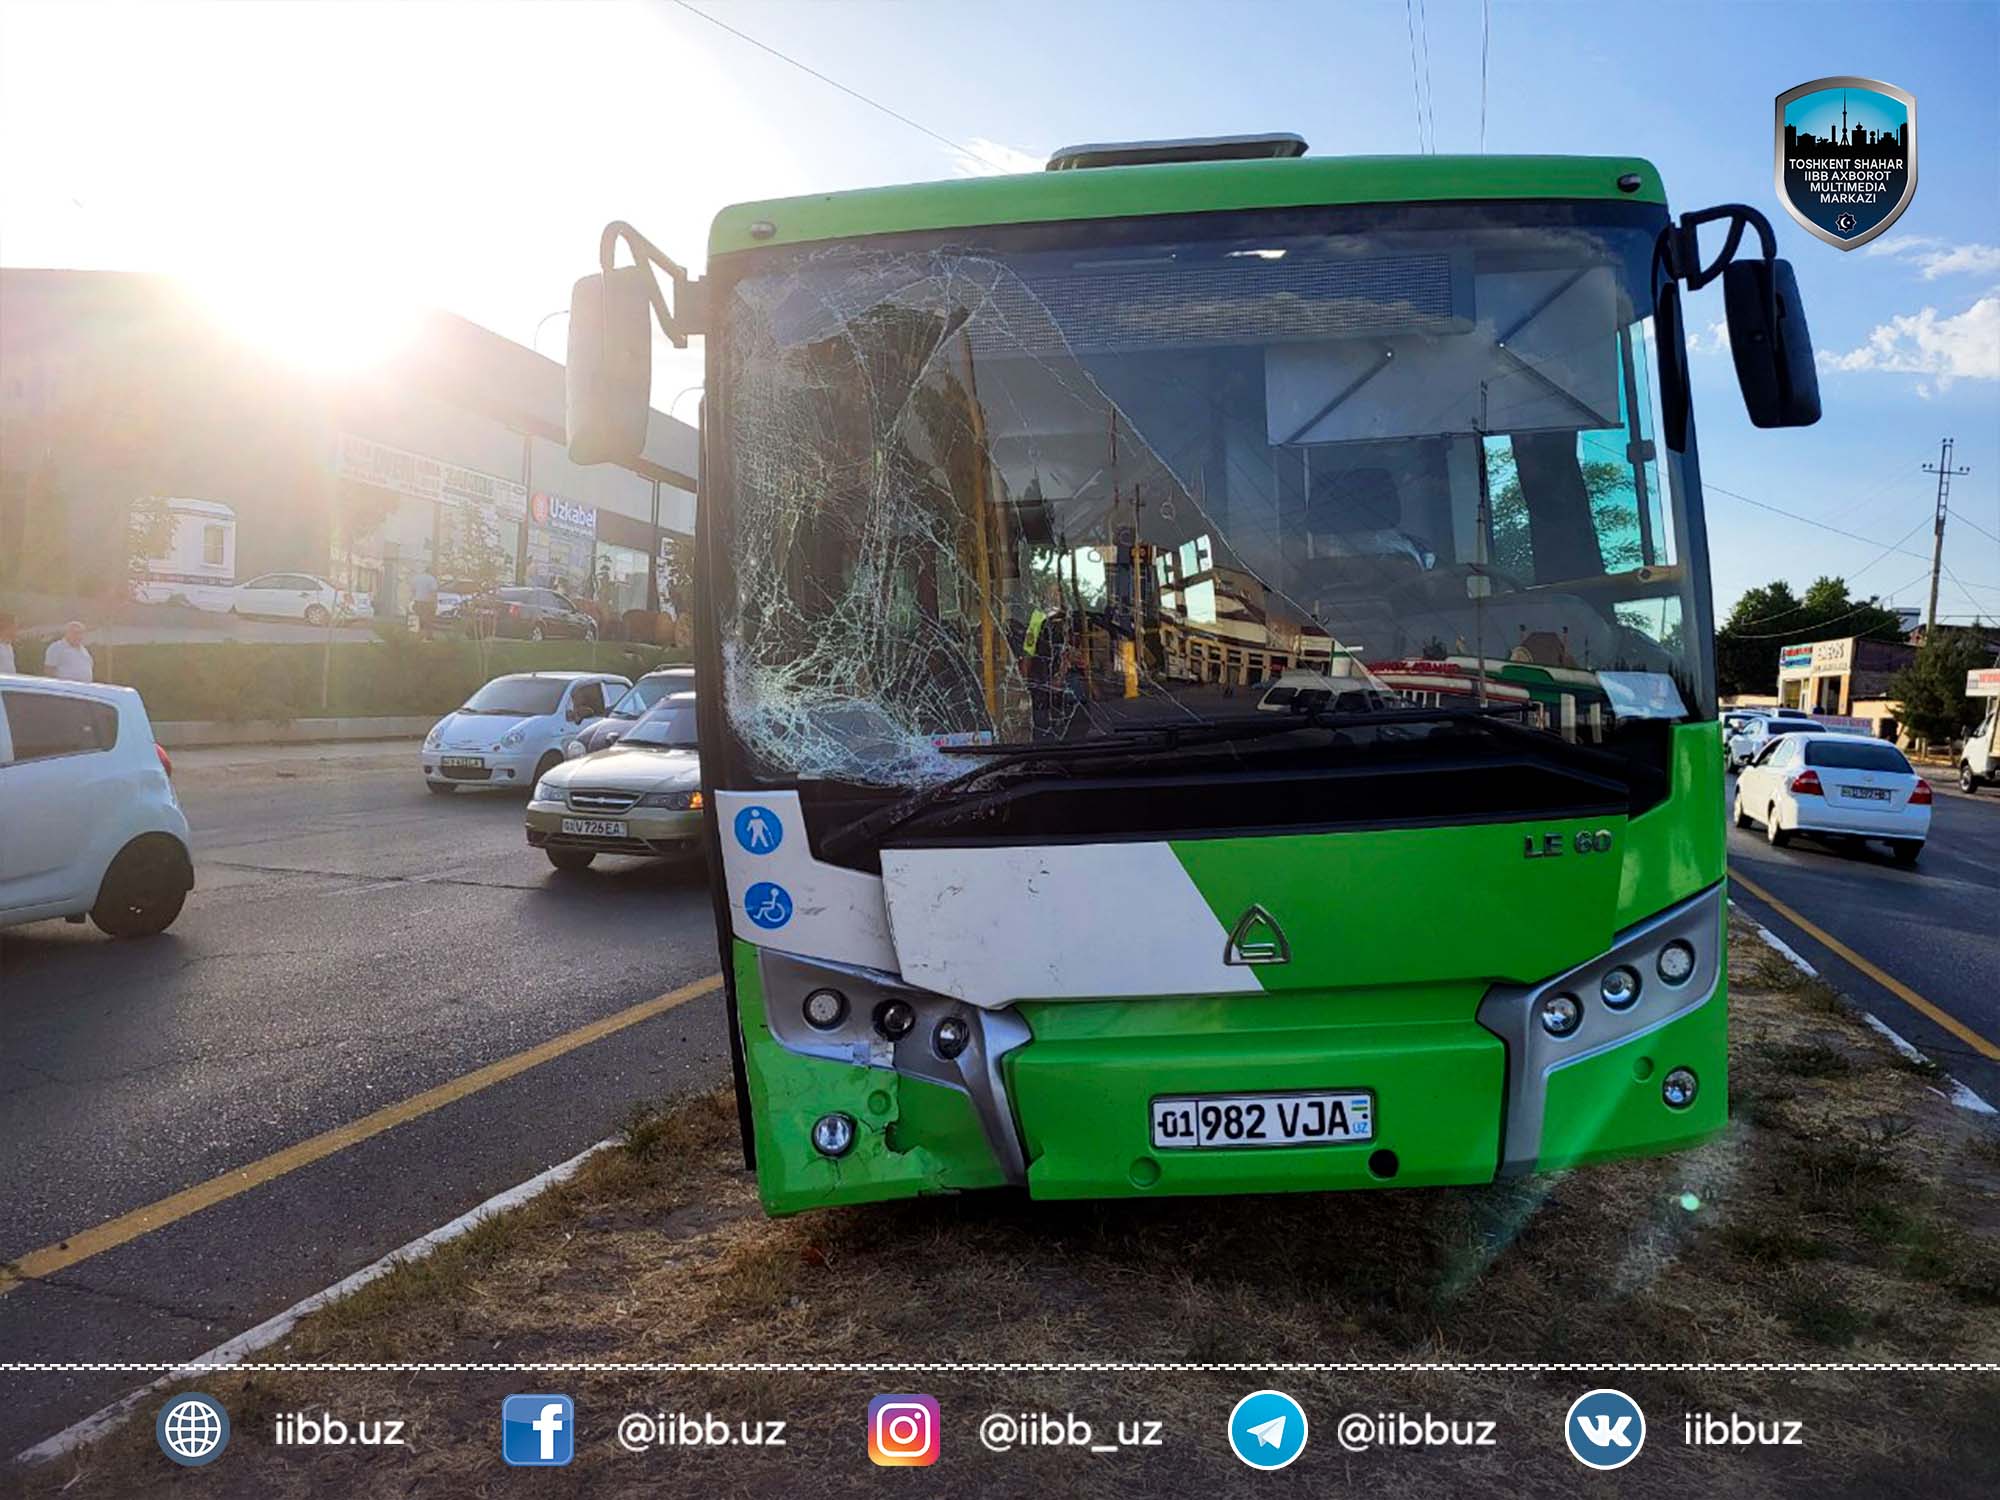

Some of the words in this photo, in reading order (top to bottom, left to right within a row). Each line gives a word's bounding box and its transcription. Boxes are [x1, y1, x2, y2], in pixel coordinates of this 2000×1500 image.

[550, 497, 596, 528] Uzkabel
[1524, 833, 1564, 858] LE
[1575, 829, 1613, 854] 60
[1159, 1111, 1194, 1138] 01
[1201, 1104, 1266, 1140] 982
[1277, 1101, 1350, 1138] VJA
[1352, 1121, 1369, 1134] UZ
